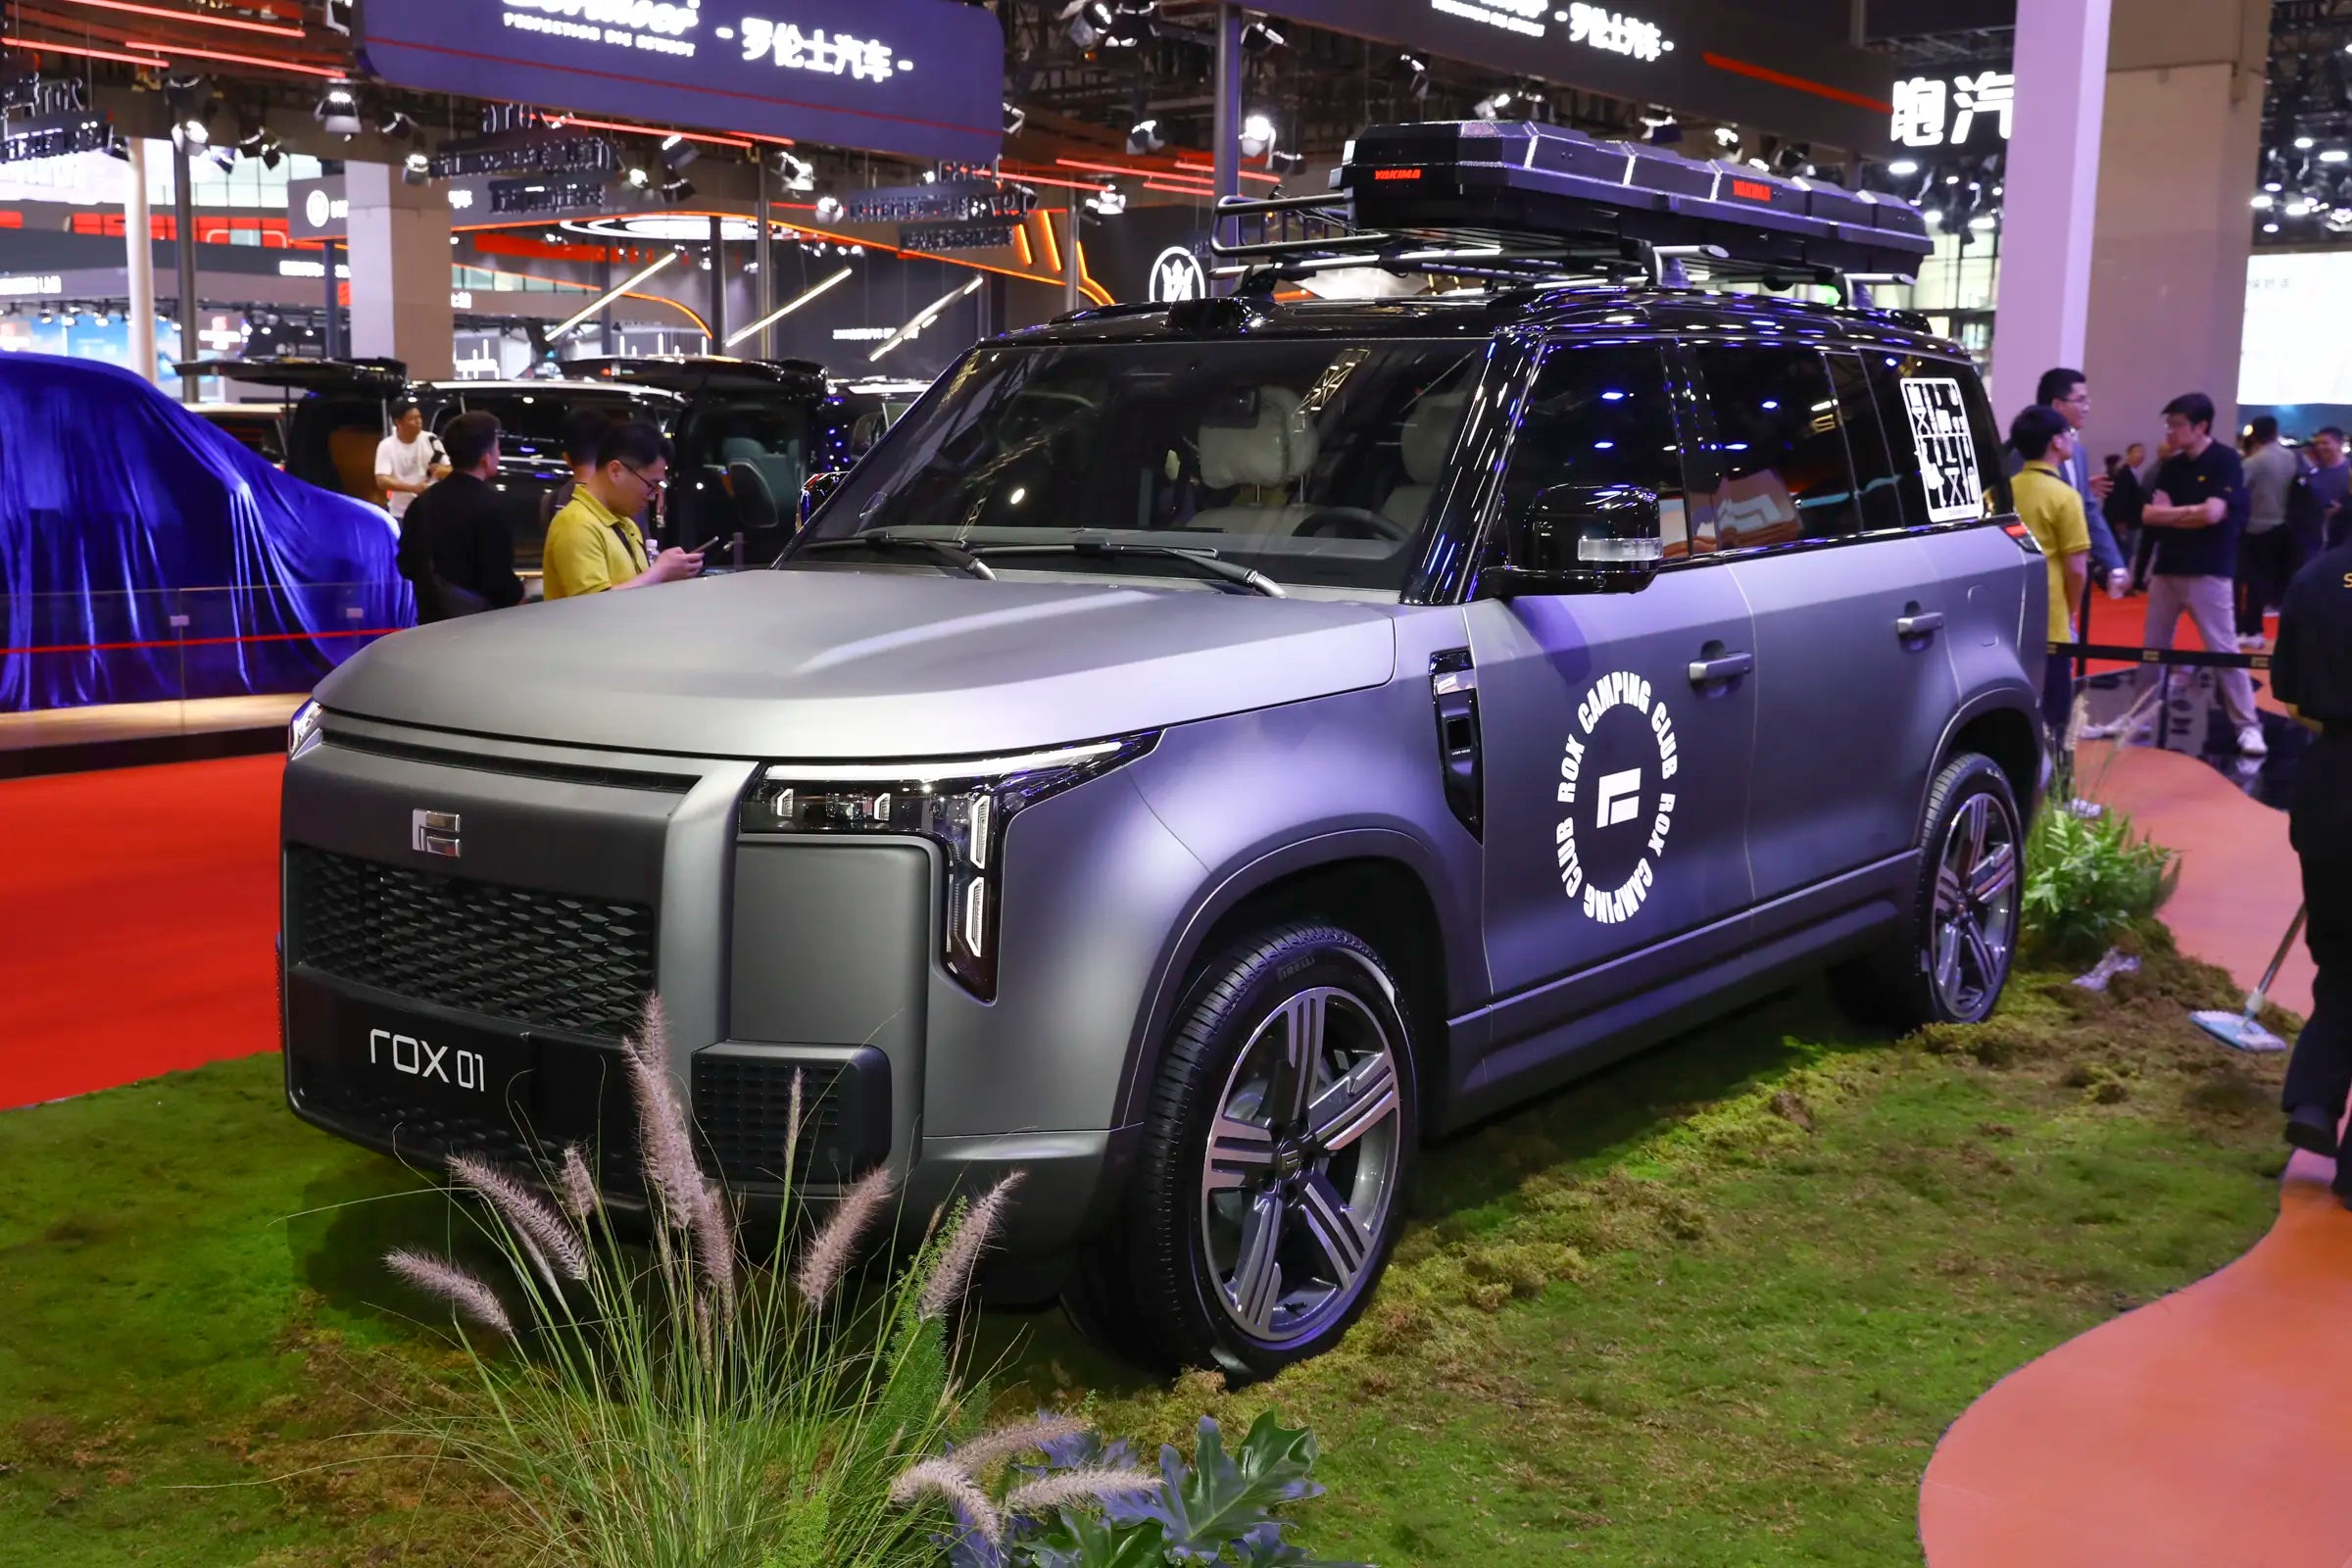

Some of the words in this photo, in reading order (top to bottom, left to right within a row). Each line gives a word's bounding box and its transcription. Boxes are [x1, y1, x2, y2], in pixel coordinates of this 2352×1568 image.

[1374, 168, 1422, 180] YAKIMA
[1578, 671, 1651, 734] CAMPING
[1557, 733, 1585, 803] ROX
[1651, 702, 1678, 779] CLUB
[1556, 816, 1583, 898] CLUB
[1648, 793, 1676, 858] ROX
[1583, 858, 1653, 924] CAMPING
[457, 1050, 484, 1092] 01
